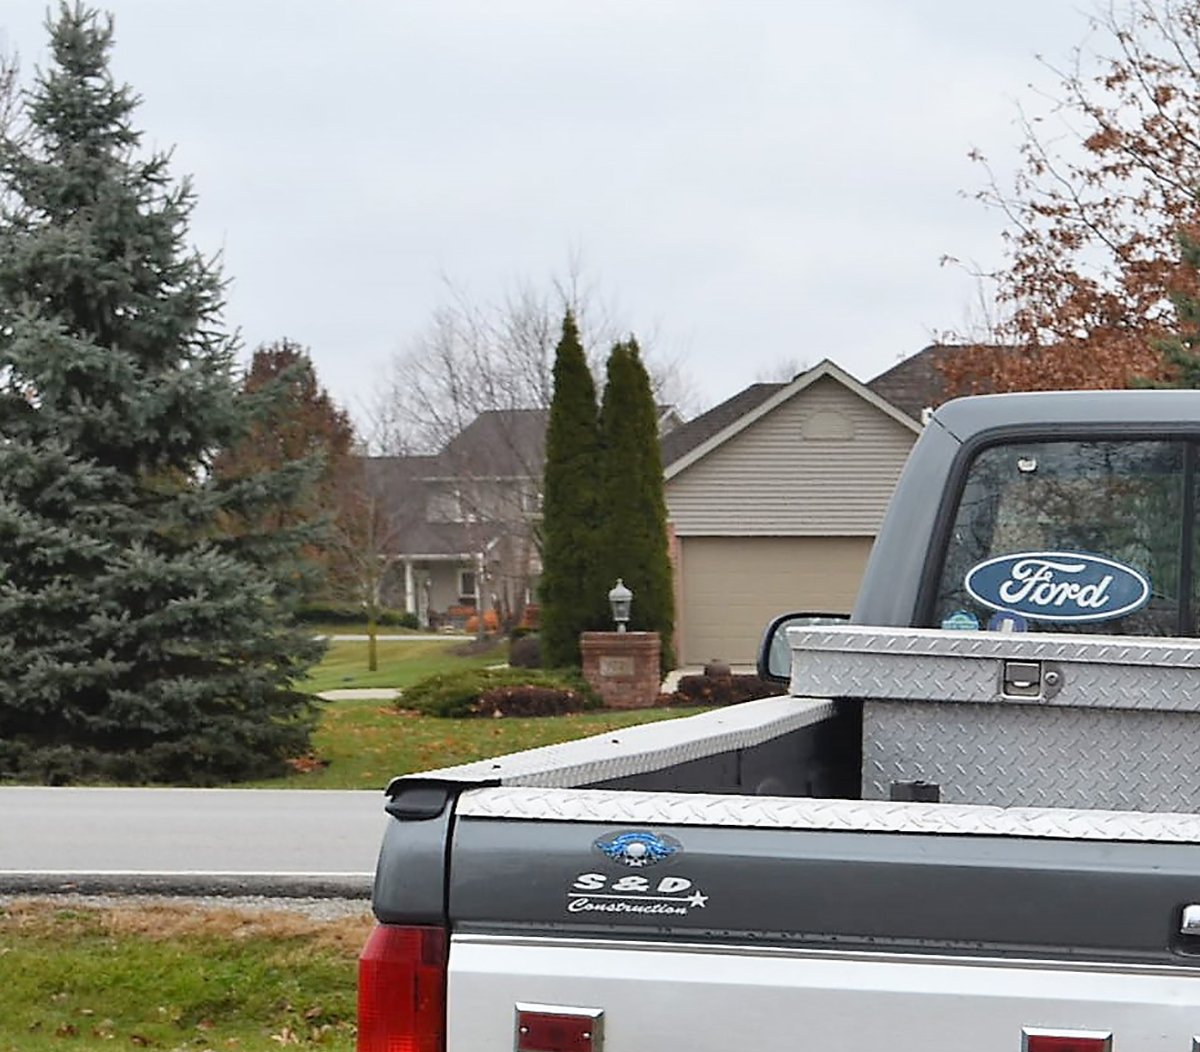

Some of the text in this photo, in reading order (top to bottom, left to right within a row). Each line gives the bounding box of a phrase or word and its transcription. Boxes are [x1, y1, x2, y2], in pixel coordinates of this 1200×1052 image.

[1000, 559, 1114, 608] Ford
[573, 873, 692, 893] S & D
[567, 898, 688, 915] Construction
